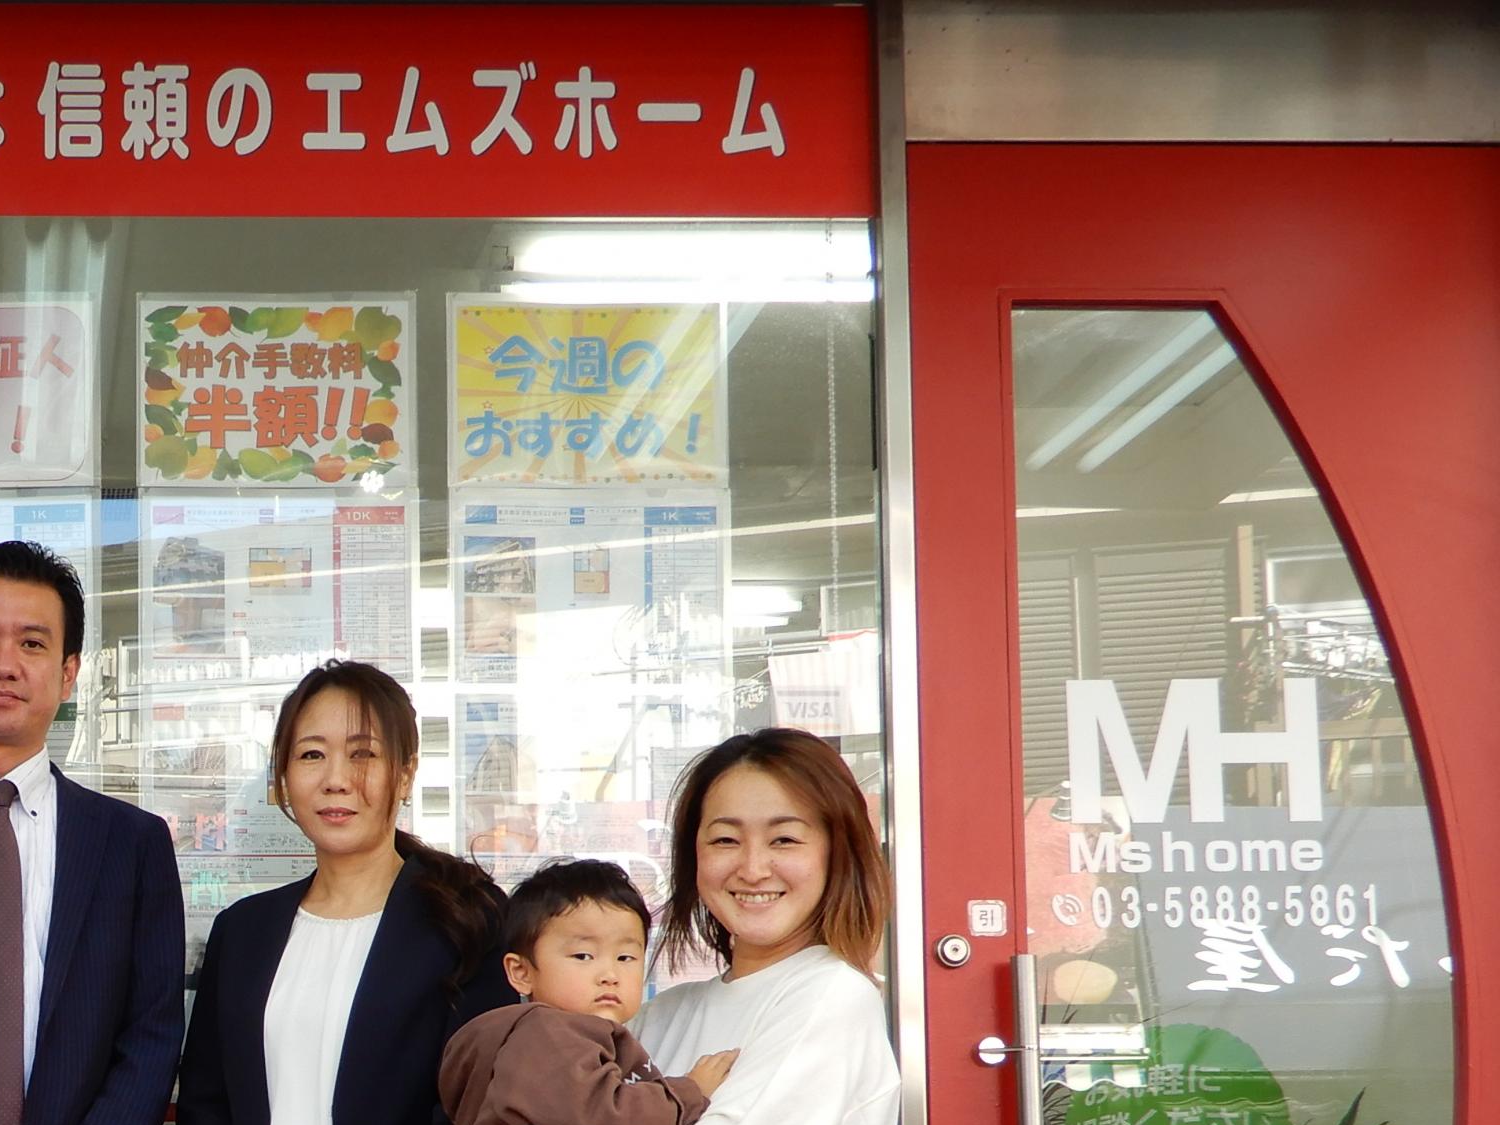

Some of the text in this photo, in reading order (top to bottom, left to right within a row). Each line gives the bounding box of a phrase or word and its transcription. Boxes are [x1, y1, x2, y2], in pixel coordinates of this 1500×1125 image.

[176, 341, 366, 380] 仲介手数料
[488, 335, 667, 394] 今週の
[31, 510, 47, 520] 1K
[345, 510, 372, 521] 1DK
[662, 511, 678, 521] 1K
[785, 701, 835, 719] VISA
[1066, 677, 1324, 824] MH
[1069, 831, 1324, 874] Mshome
[1091, 884, 1378, 928] 03-5888-5861
